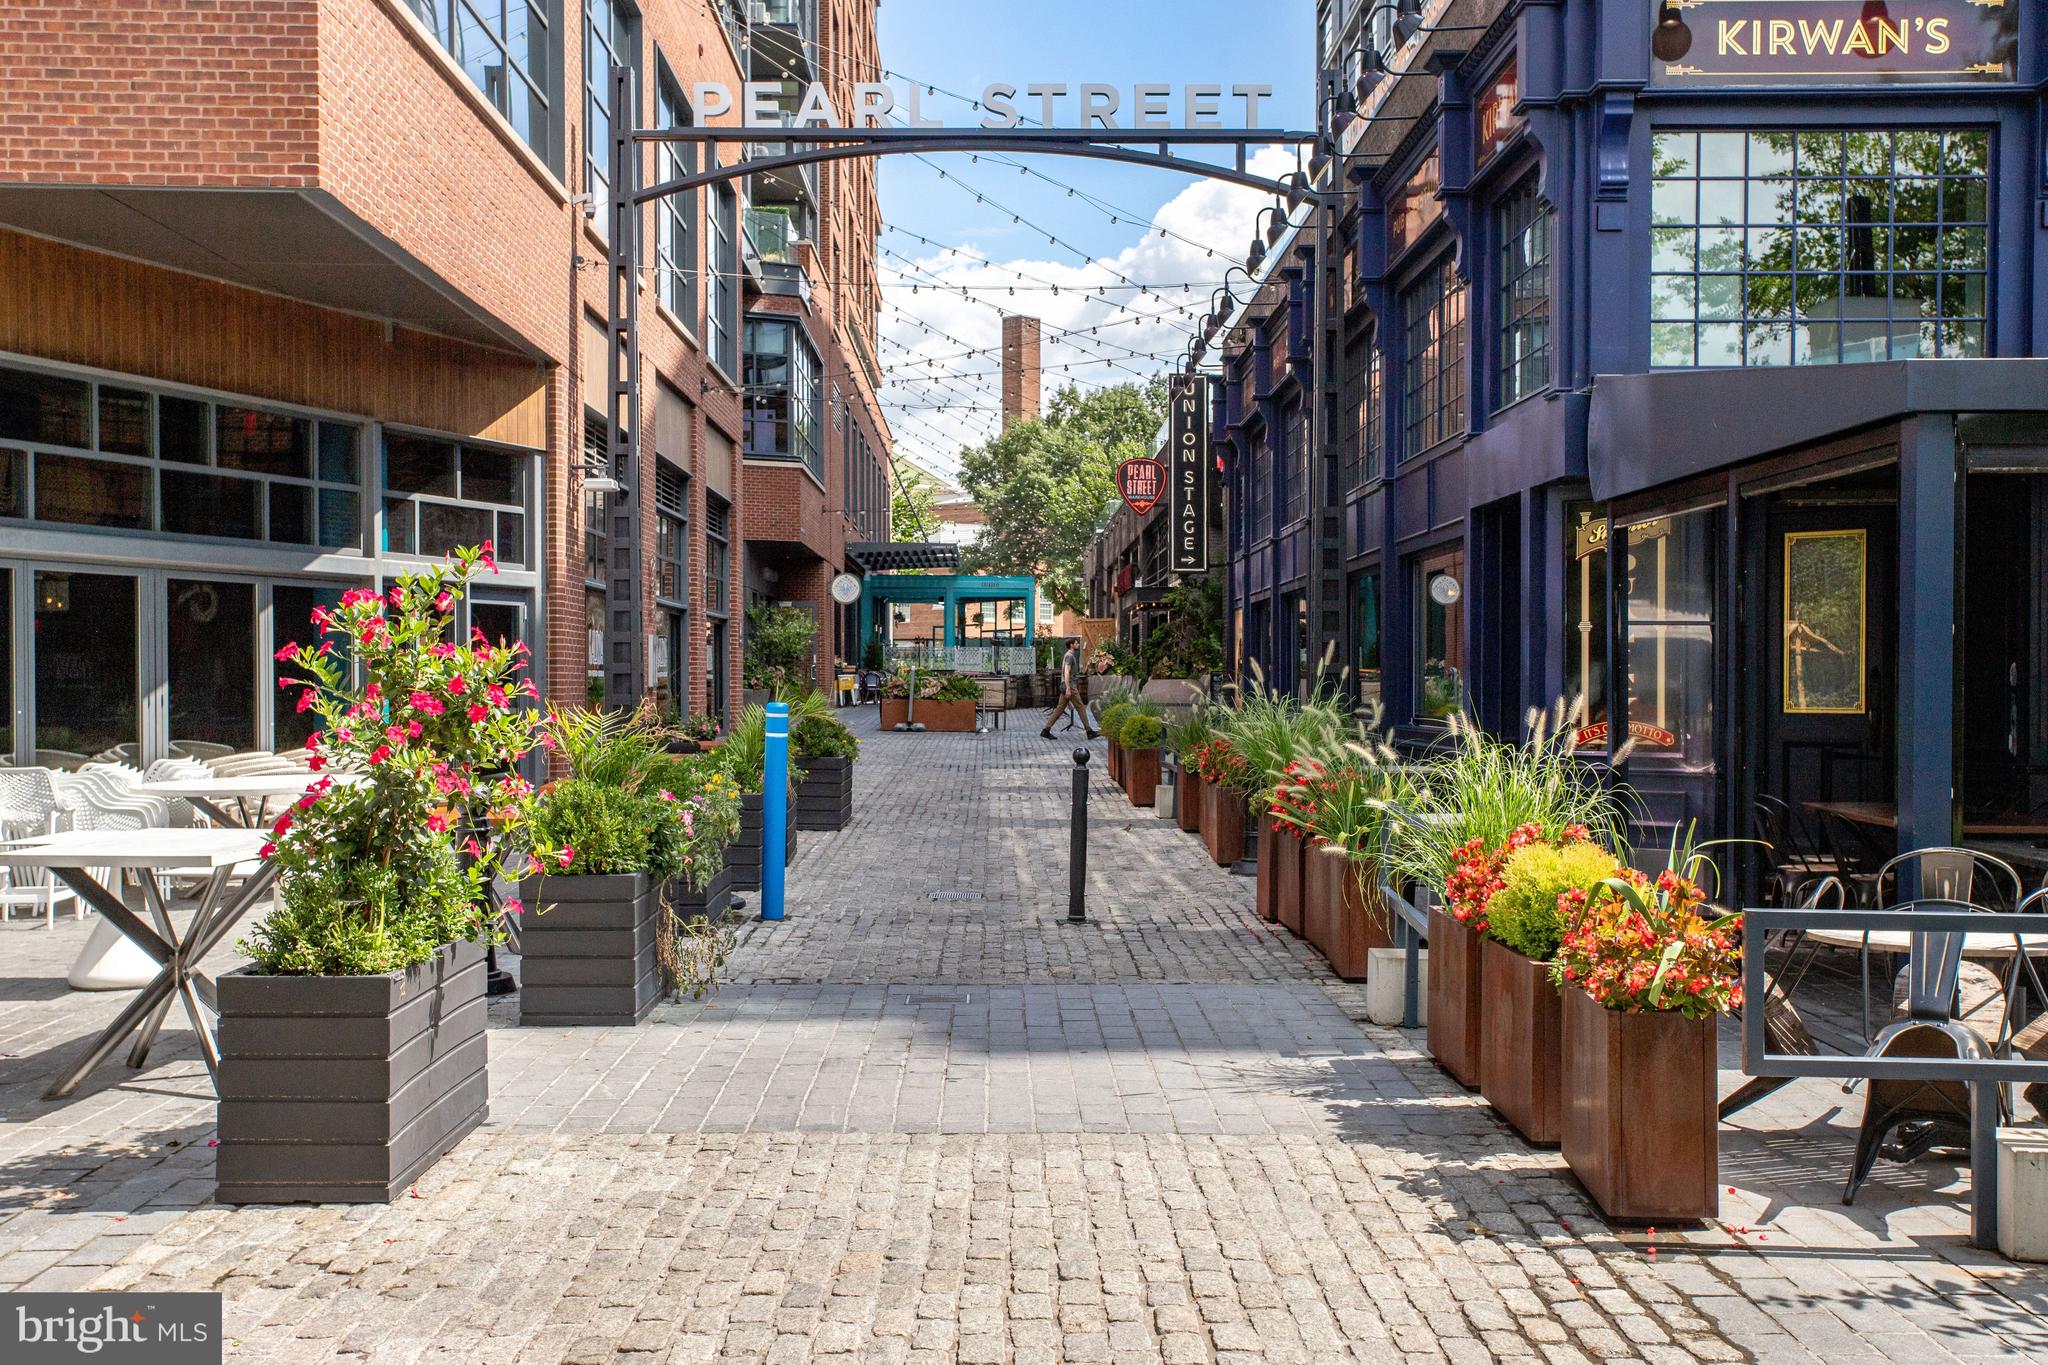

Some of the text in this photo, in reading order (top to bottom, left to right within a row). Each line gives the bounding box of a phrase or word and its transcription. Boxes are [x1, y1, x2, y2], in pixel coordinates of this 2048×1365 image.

[1718, 17, 1951, 55] KIRWAN'S
[693, 82, 1273, 129] PEARL STREET
[1127, 464, 1157, 480] PEARL
[1126, 480, 1157, 495] STREET
[1183, 470, 1196, 550] STAGE
[1583, 726, 1601, 739] IT'S
